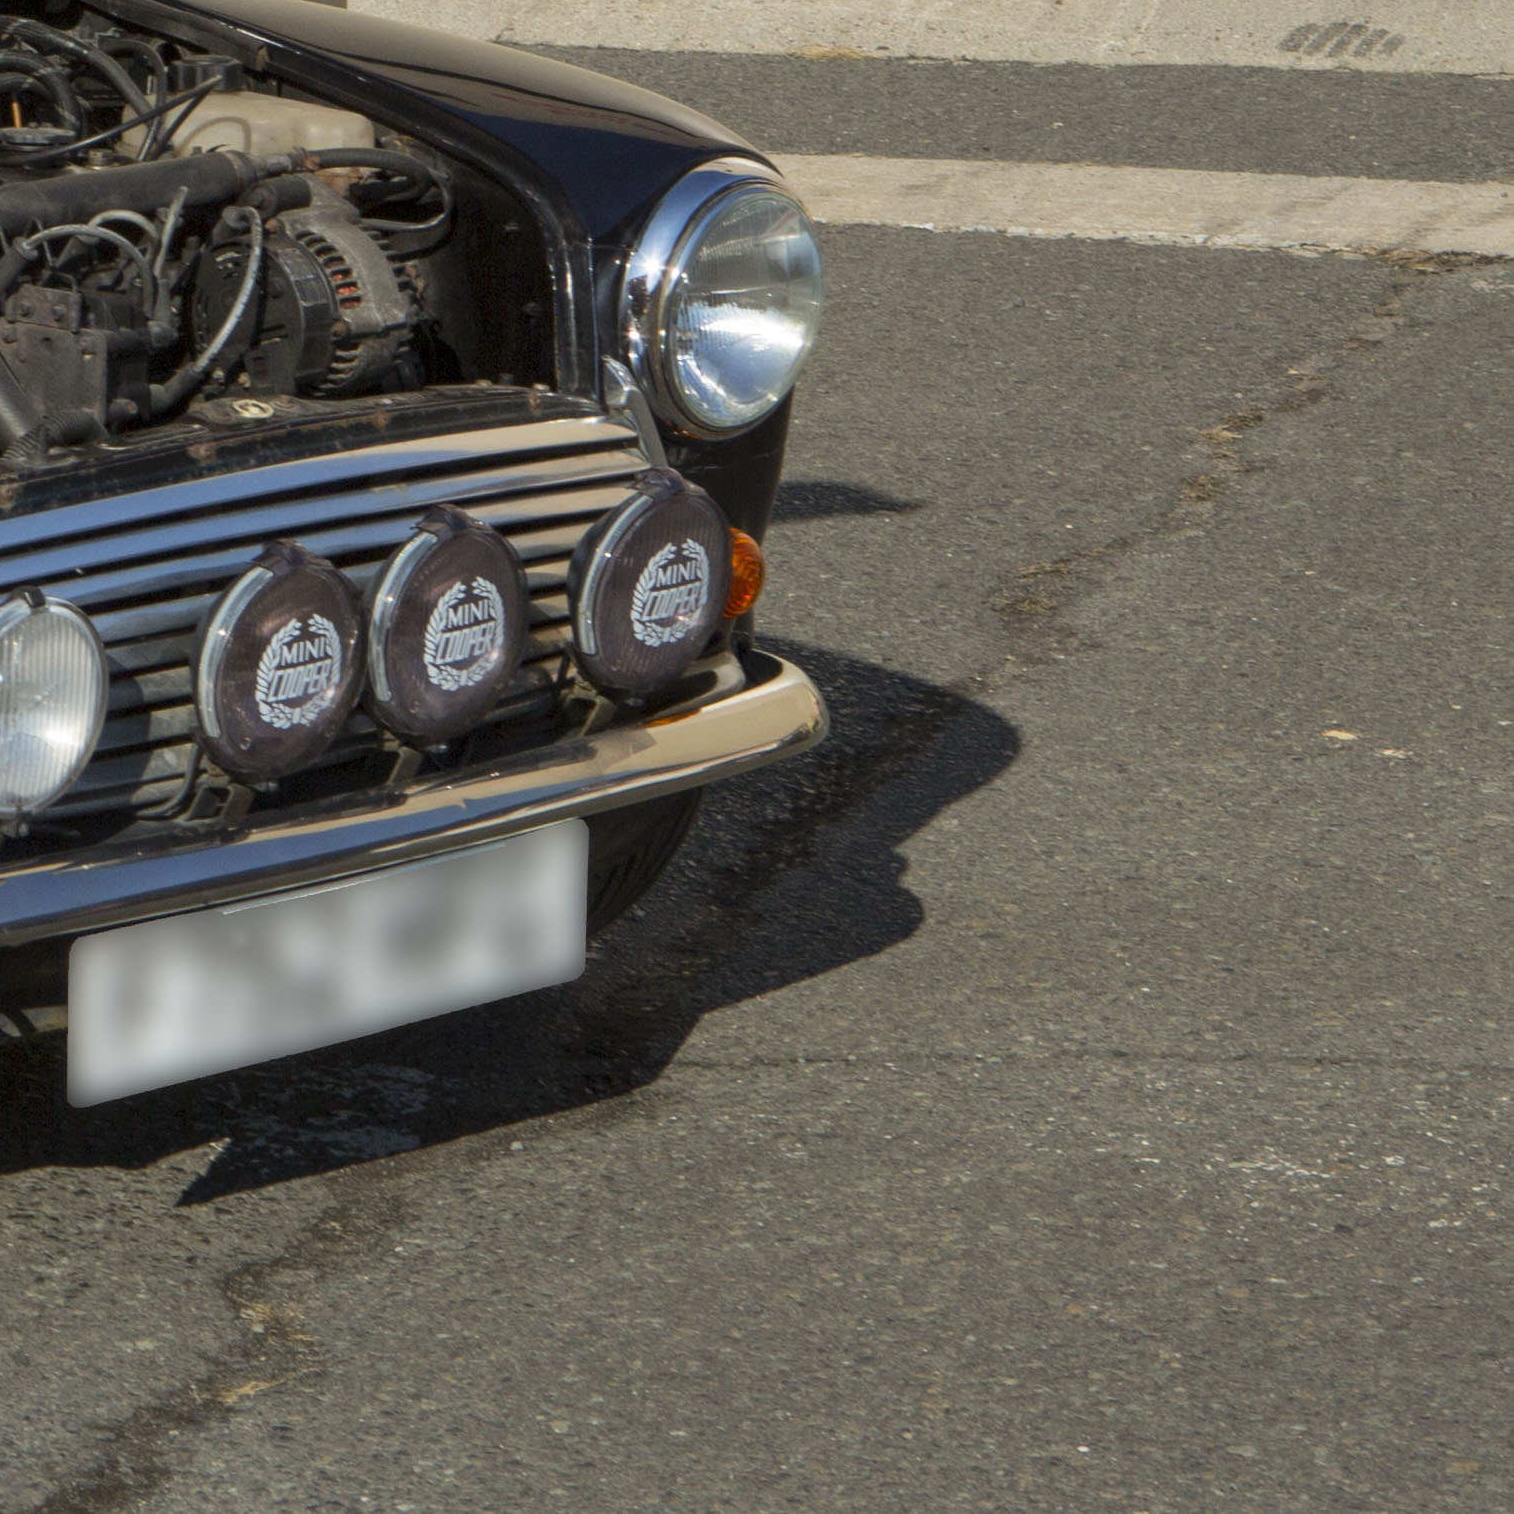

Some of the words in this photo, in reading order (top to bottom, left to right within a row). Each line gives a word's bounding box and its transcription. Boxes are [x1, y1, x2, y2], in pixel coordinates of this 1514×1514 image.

[656, 560, 696, 588] MINI
[447, 599, 489, 628] MINI
[641, 581, 701, 622] COOPER
[281, 637, 325, 666] MINI
[436, 621, 495, 665] COOPER
[268, 659, 332, 702] COOPER
